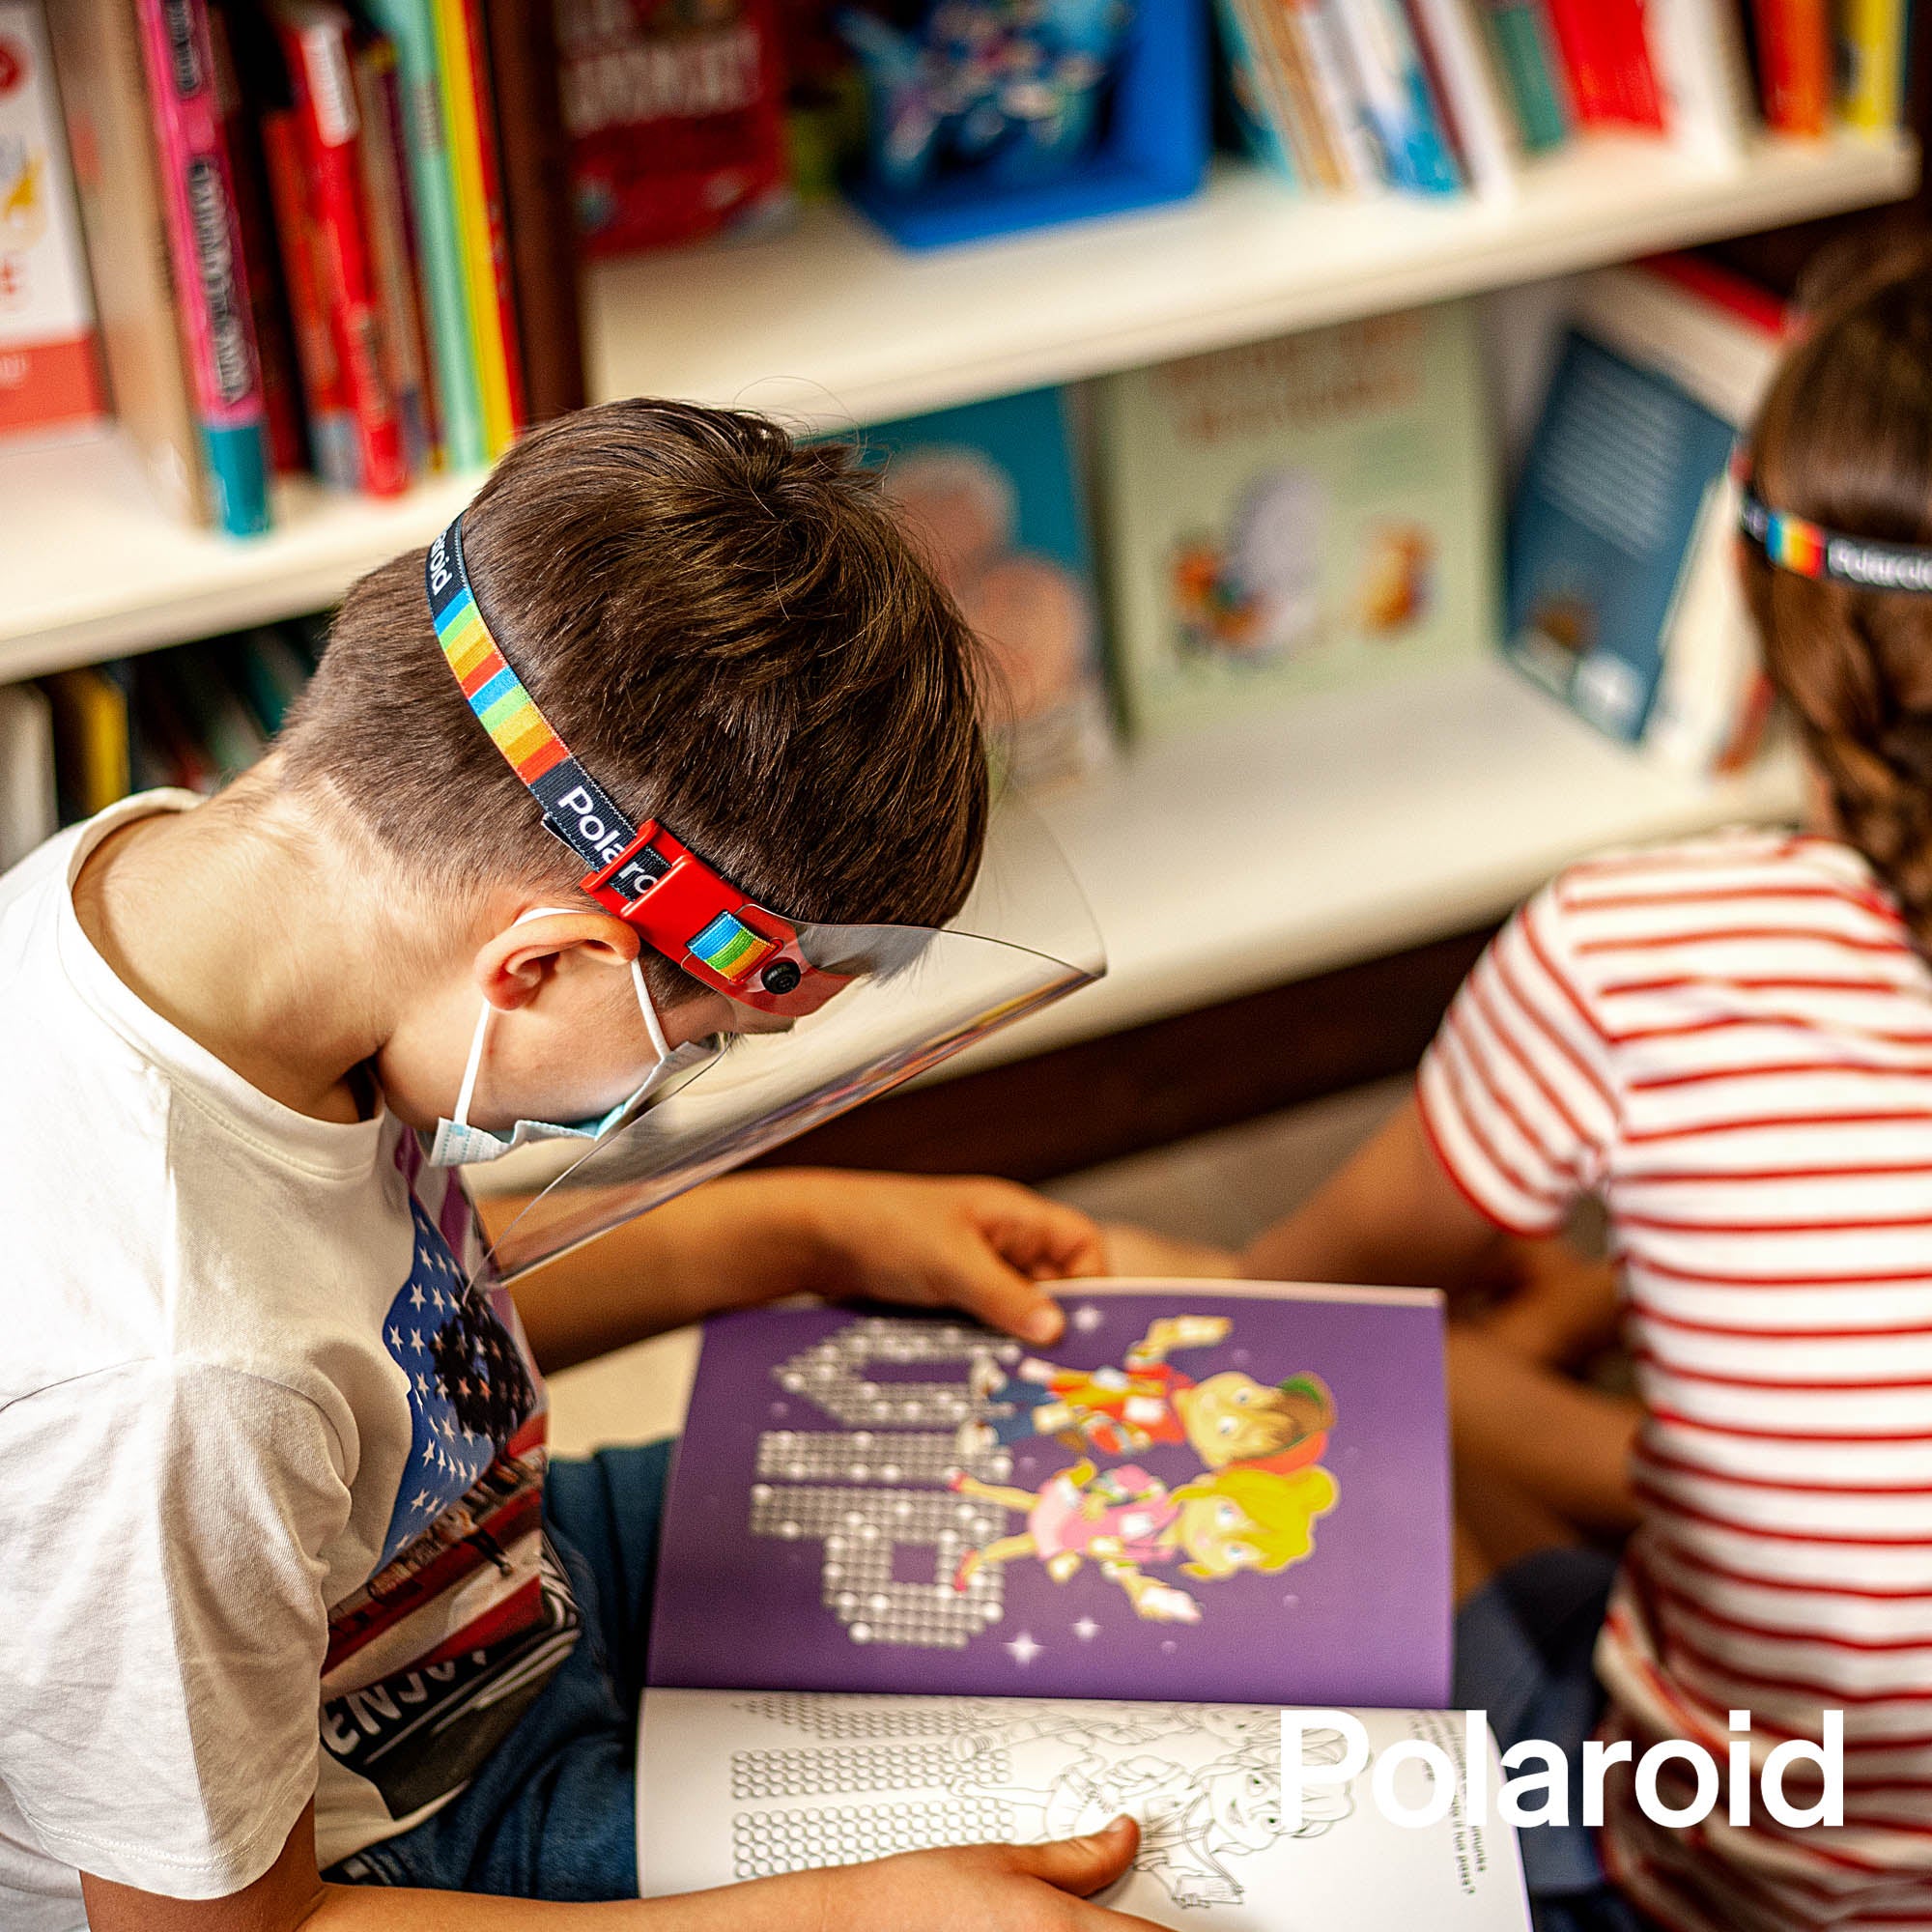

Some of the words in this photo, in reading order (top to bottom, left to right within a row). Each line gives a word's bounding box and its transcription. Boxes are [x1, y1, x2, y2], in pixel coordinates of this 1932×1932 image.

[430, 527, 453, 596] aroid
[558, 785, 659, 895] Polaro
[320, 1649, 487, 1756] ENJO
